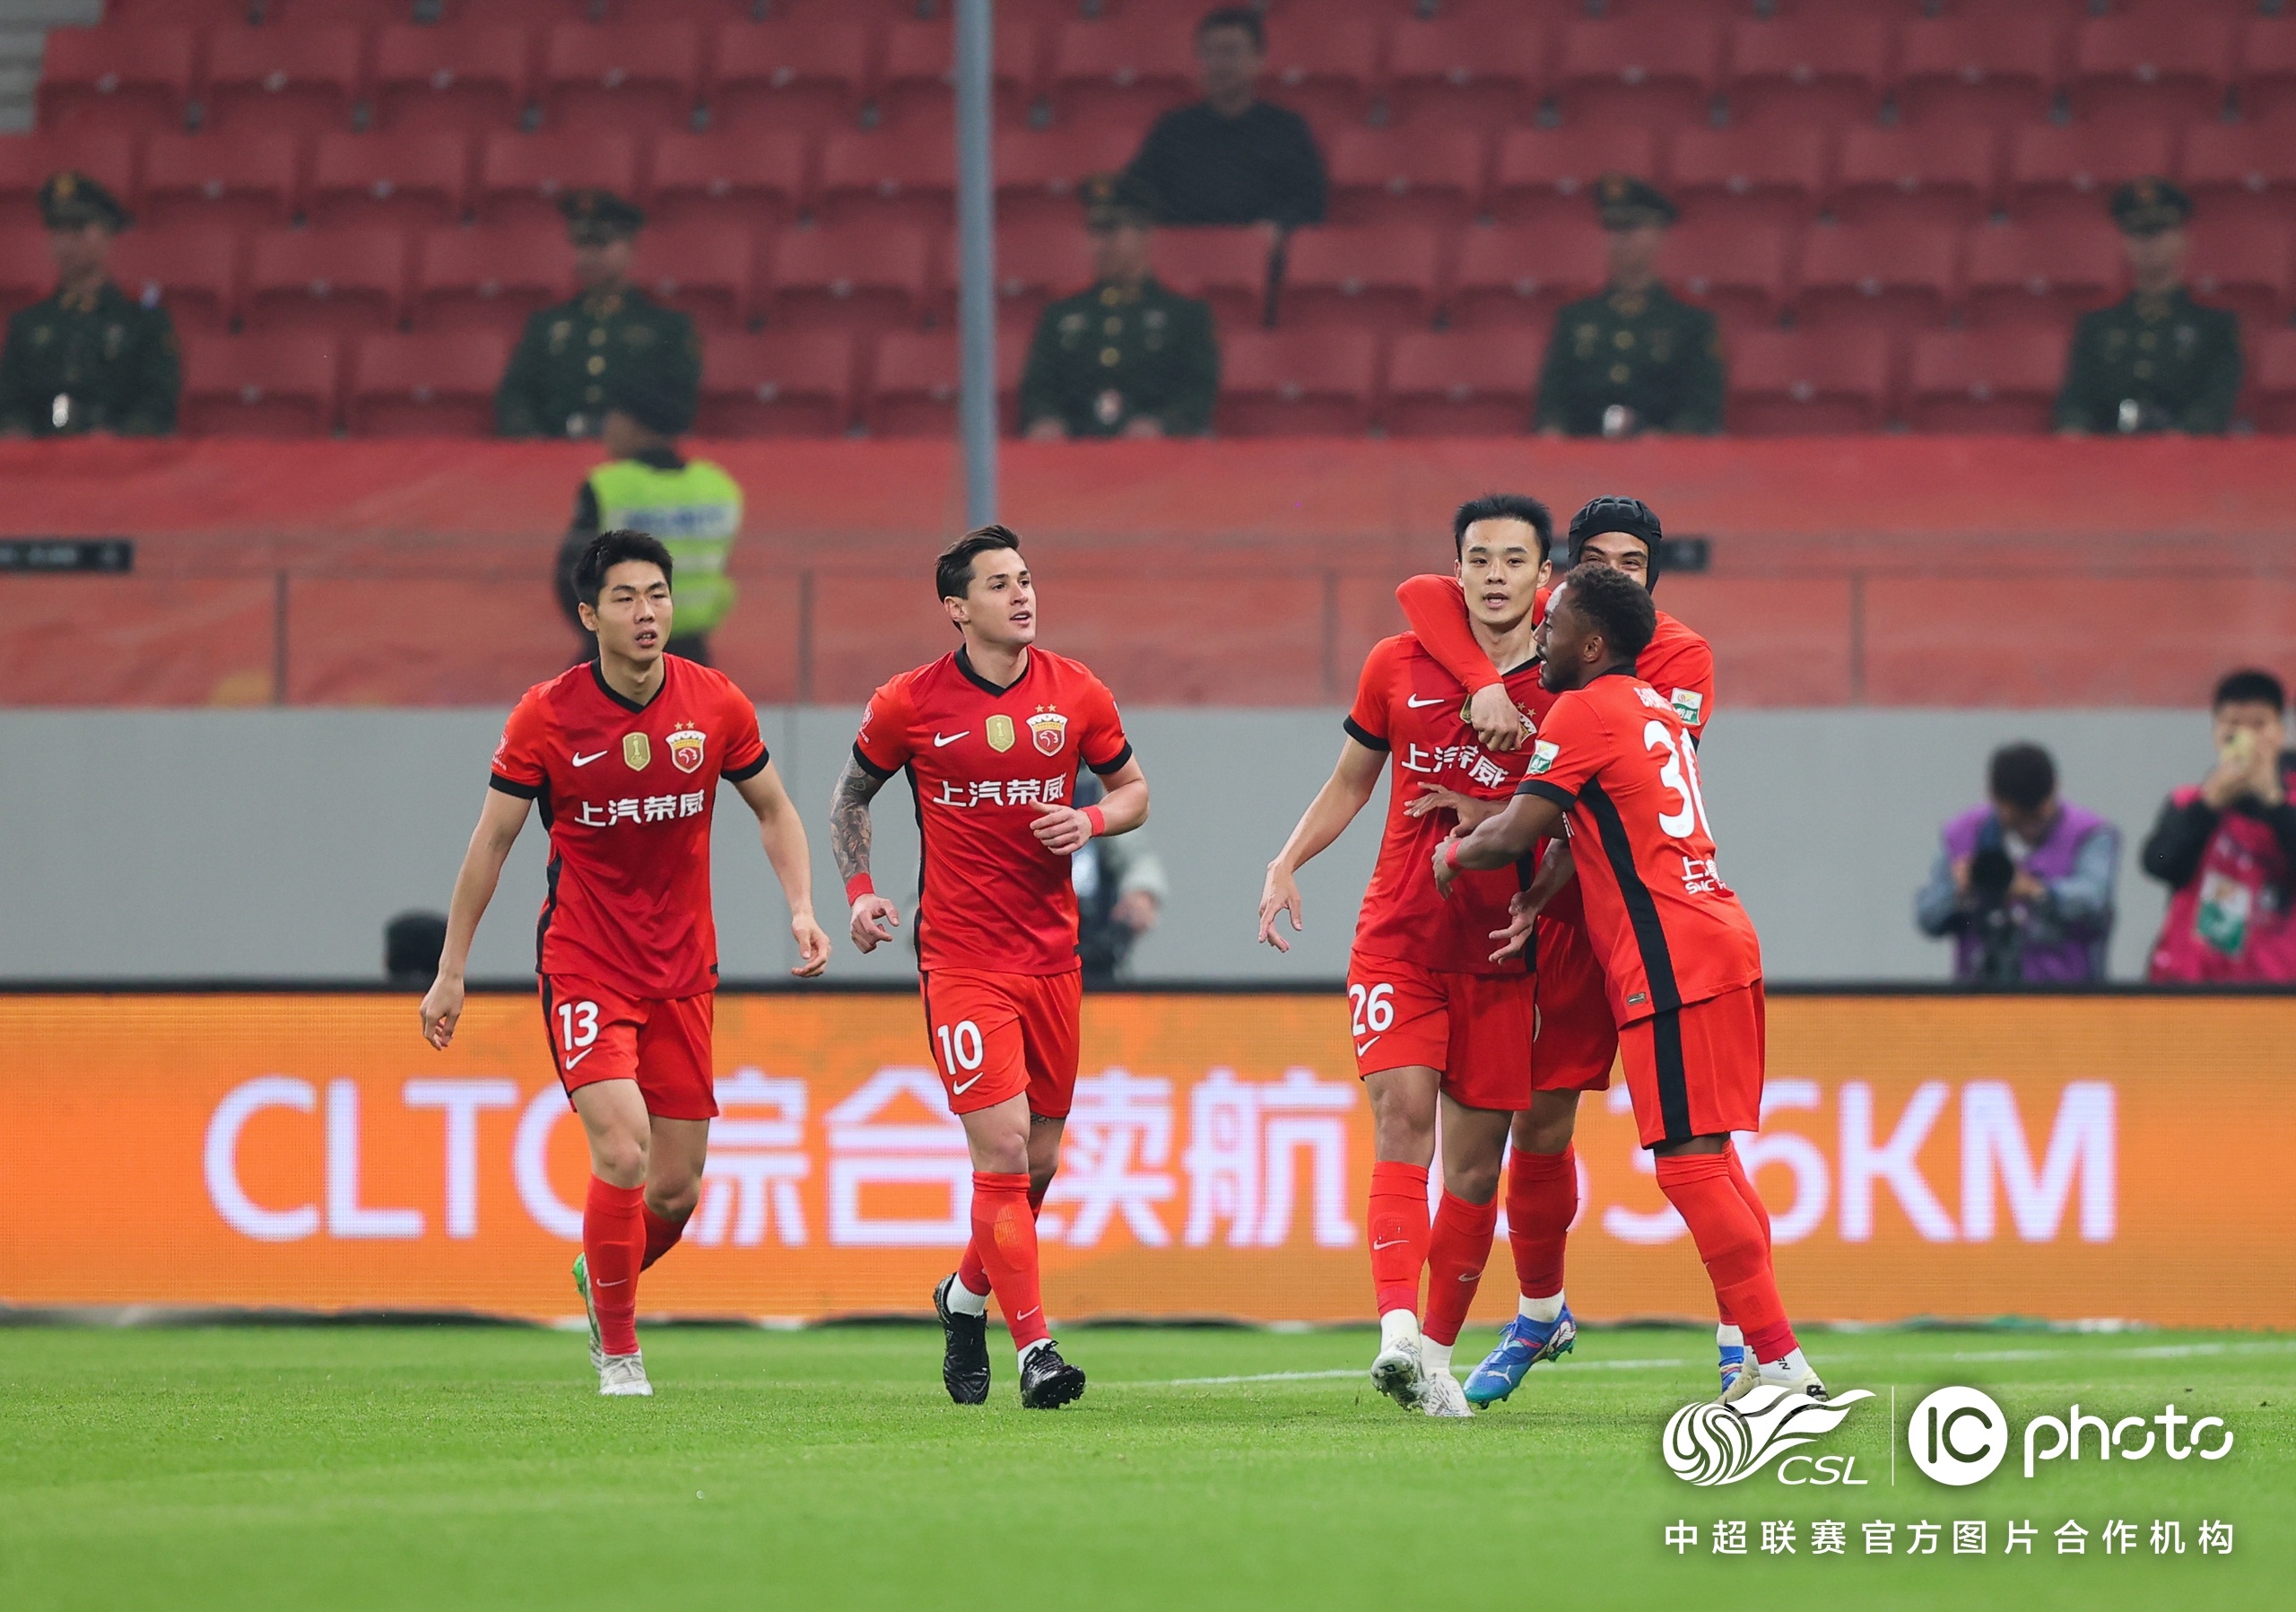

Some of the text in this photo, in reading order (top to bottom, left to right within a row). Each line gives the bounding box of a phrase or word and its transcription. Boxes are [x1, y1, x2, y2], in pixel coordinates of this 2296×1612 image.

[574, 789, 705, 827] 上汽荣威
[933, 772, 1067, 807] 上汽荣威
[558, 1000, 599, 1051] 13
[1348, 983, 1395, 1037] 26
[937, 1020, 984, 1076] 10
